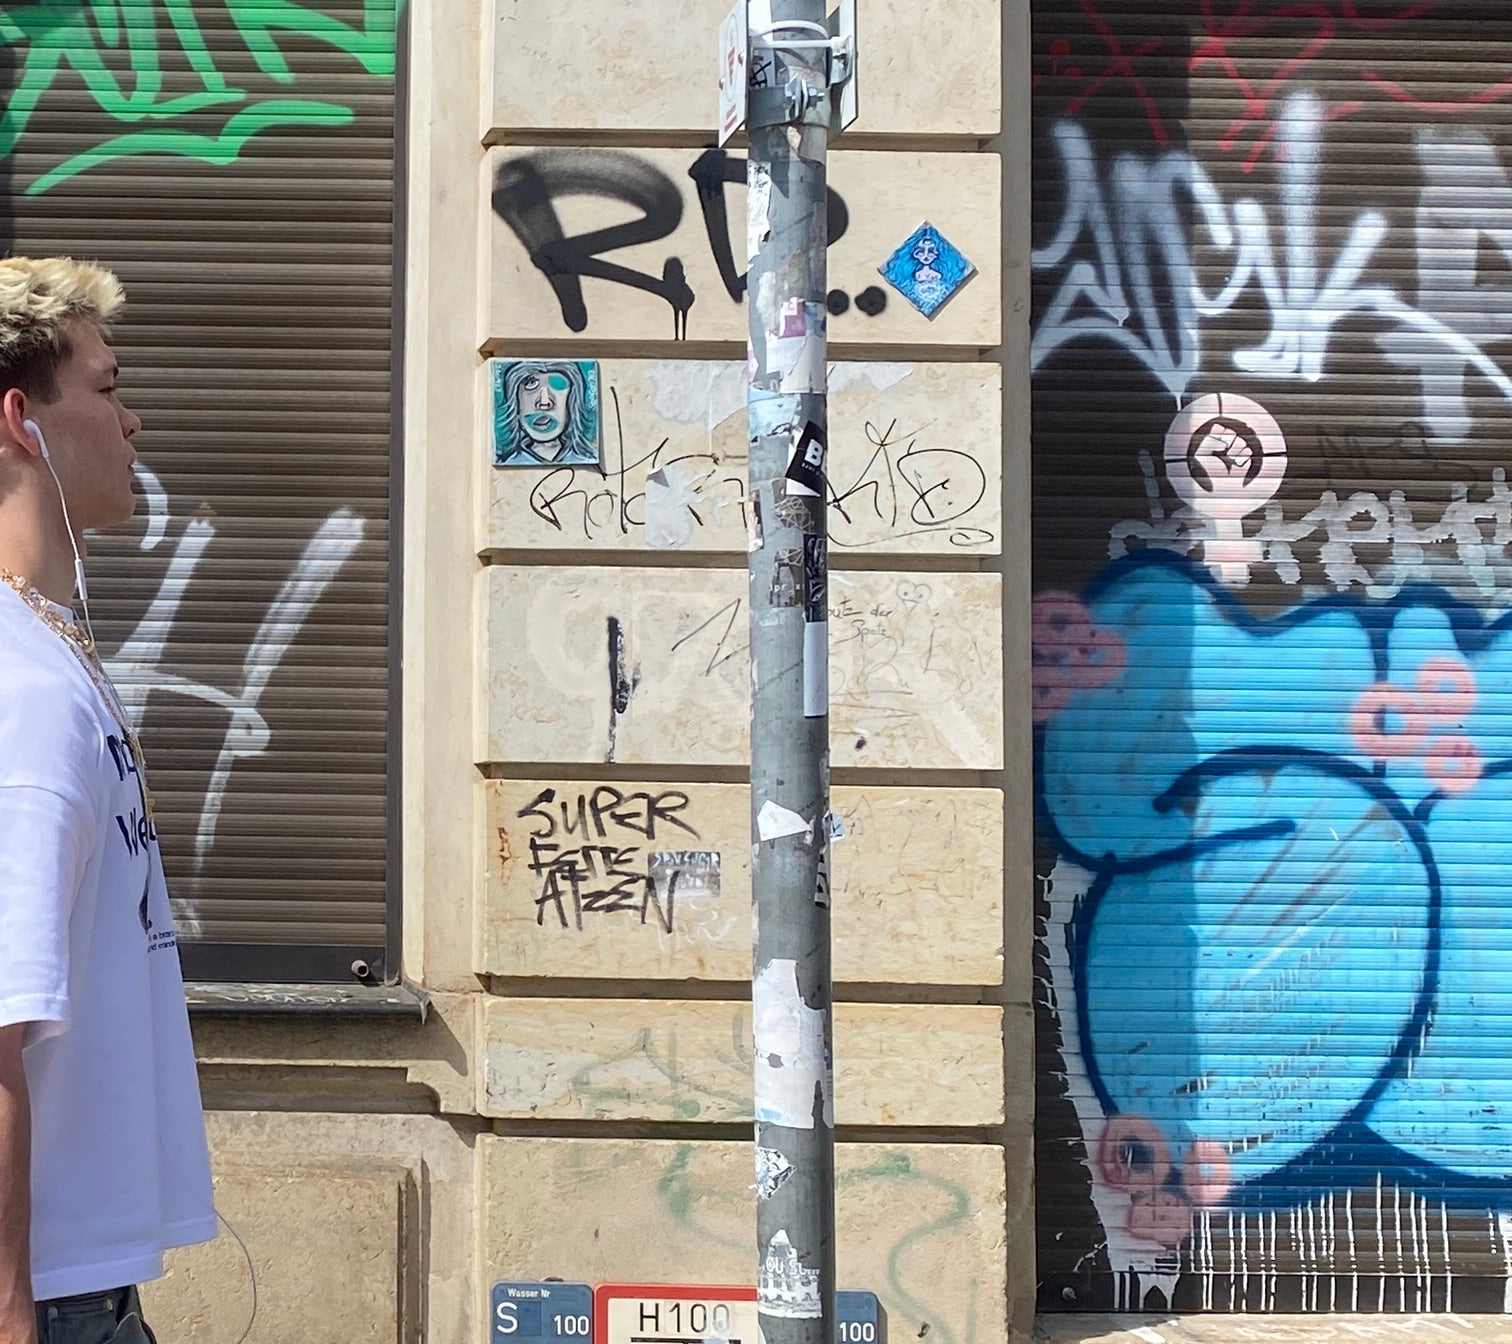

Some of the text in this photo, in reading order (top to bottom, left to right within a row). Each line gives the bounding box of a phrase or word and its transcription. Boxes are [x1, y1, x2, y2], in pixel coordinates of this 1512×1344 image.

[517, 785, 701, 842] SUPER
[496, 1302, 589, 1336] S 100
[839, 1321, 875, 1343] 100
